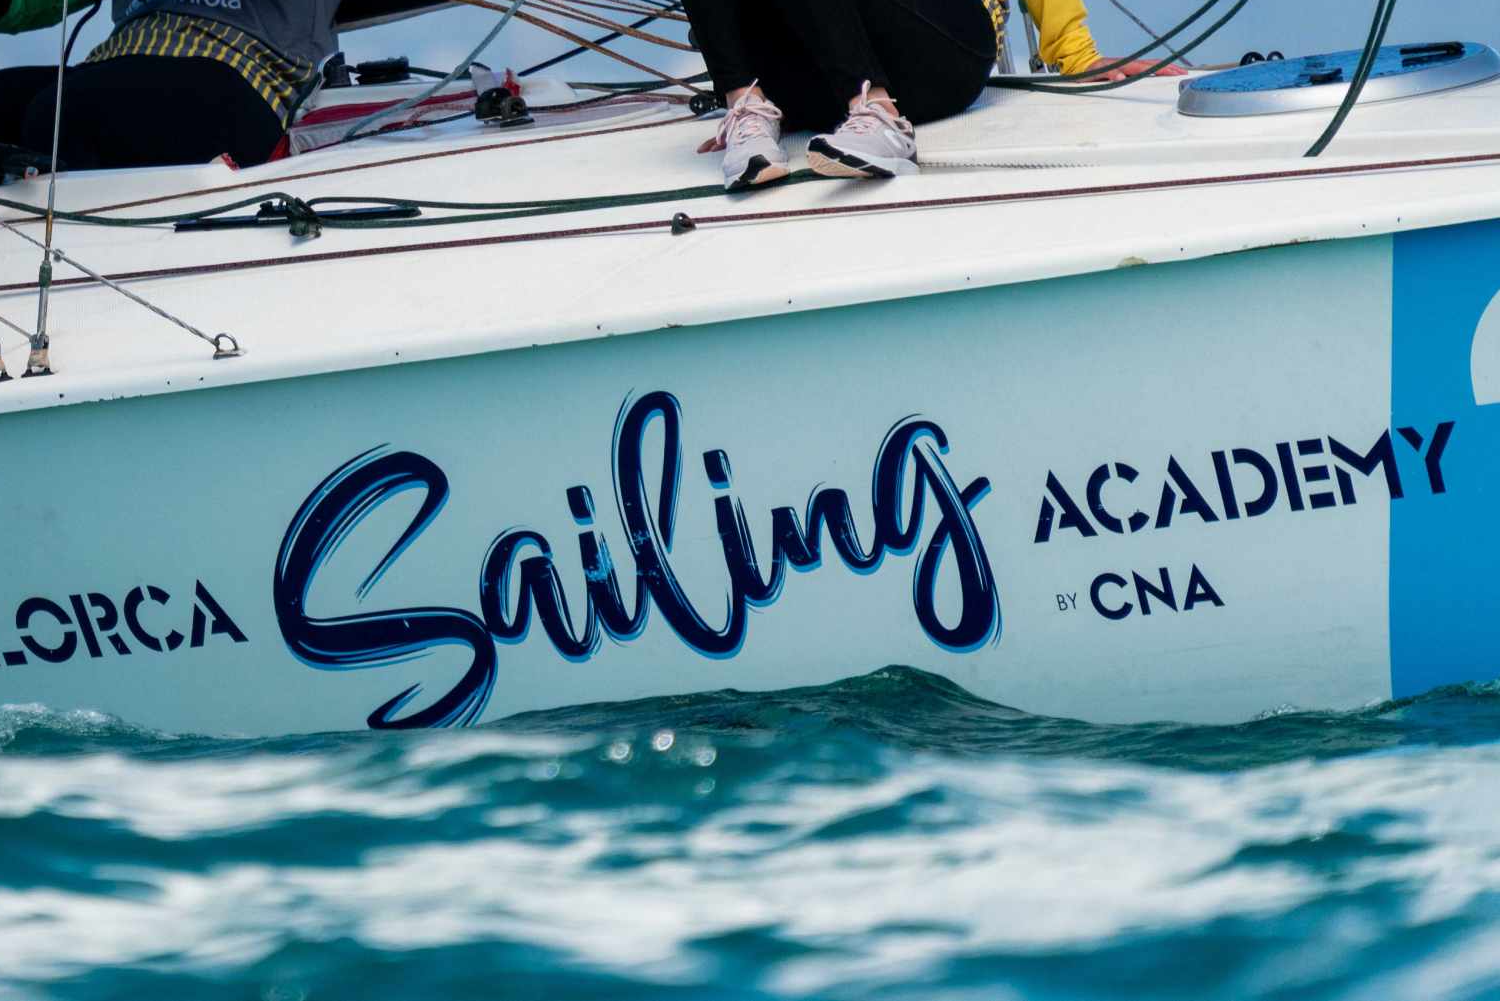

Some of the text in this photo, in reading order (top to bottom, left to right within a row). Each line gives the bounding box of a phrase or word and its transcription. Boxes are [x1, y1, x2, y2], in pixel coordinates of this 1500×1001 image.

[272, 388, 1002, 730] Sailing
[1033, 420, 1456, 543] ACADEMY
[1056, 562, 1225, 621] BY CNA
